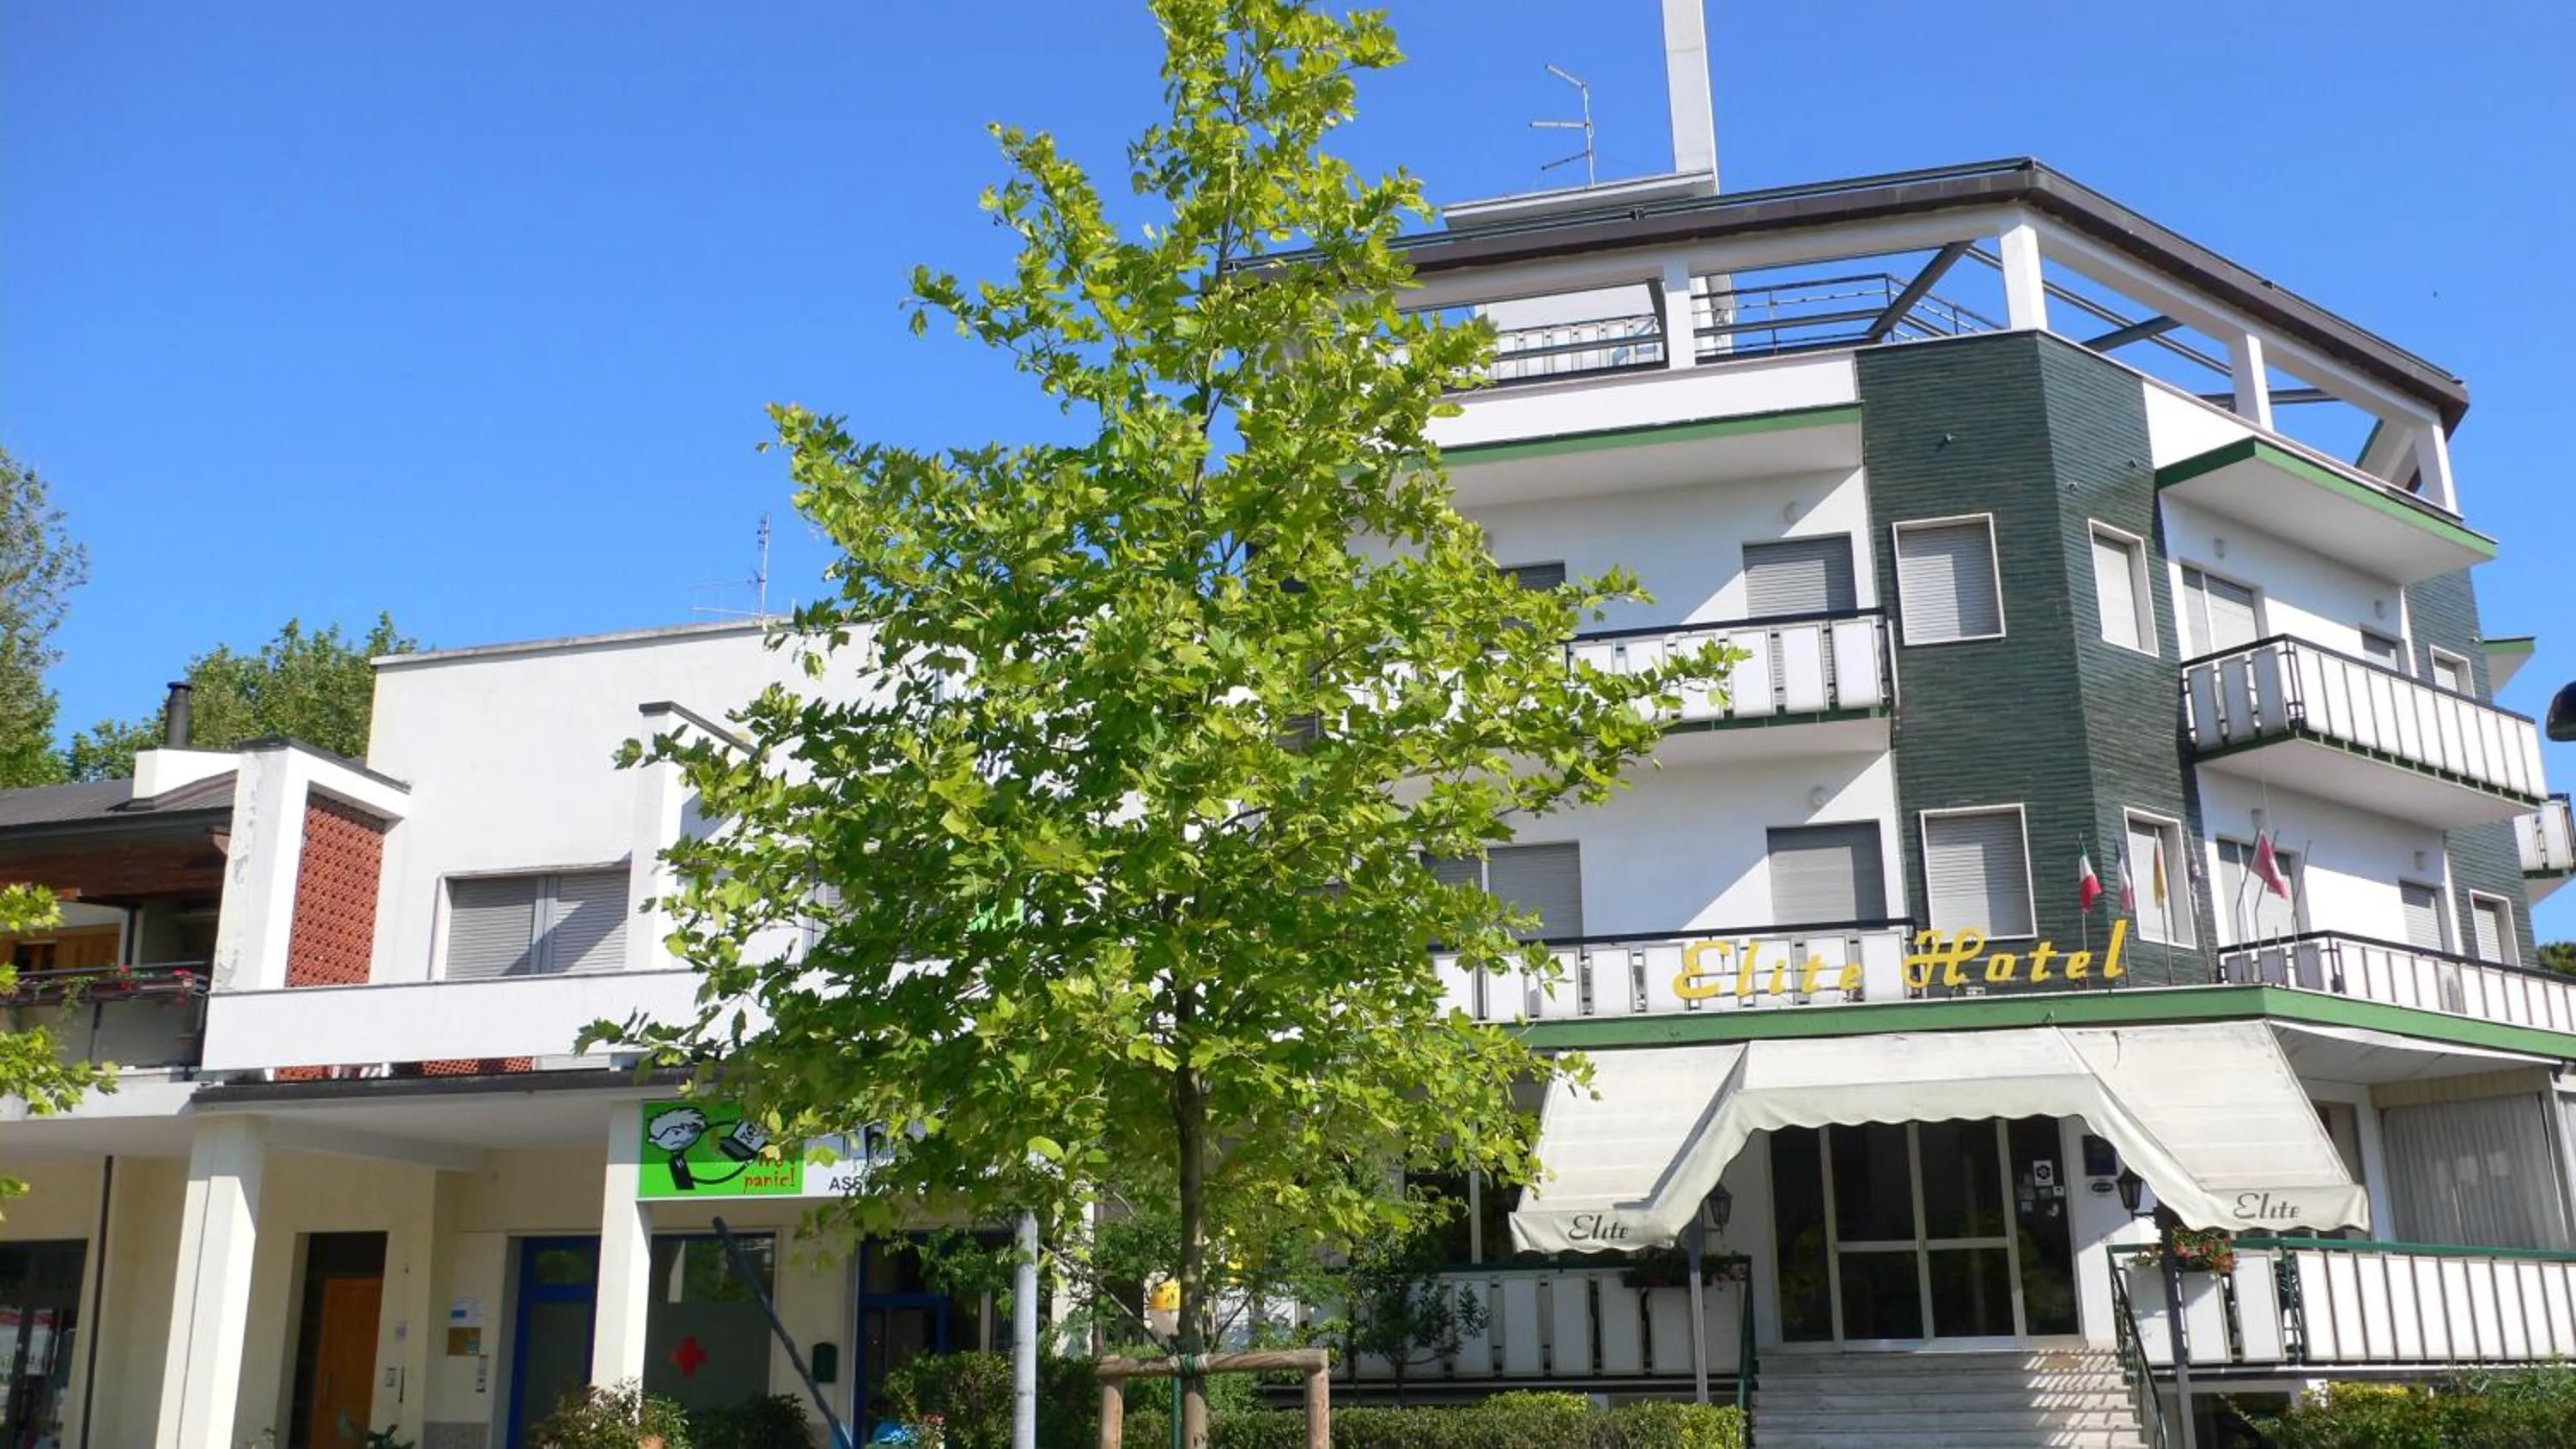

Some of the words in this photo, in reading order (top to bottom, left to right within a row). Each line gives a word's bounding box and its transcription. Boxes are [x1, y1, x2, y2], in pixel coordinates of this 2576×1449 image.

[1674, 940, 1862, 999] Elite
[1902, 919, 2129, 988] Hotel
[743, 1167, 795, 1194] panic!
[2233, 1192, 2300, 1219] Elite
[1568, 1214, 1629, 1240] Elite
